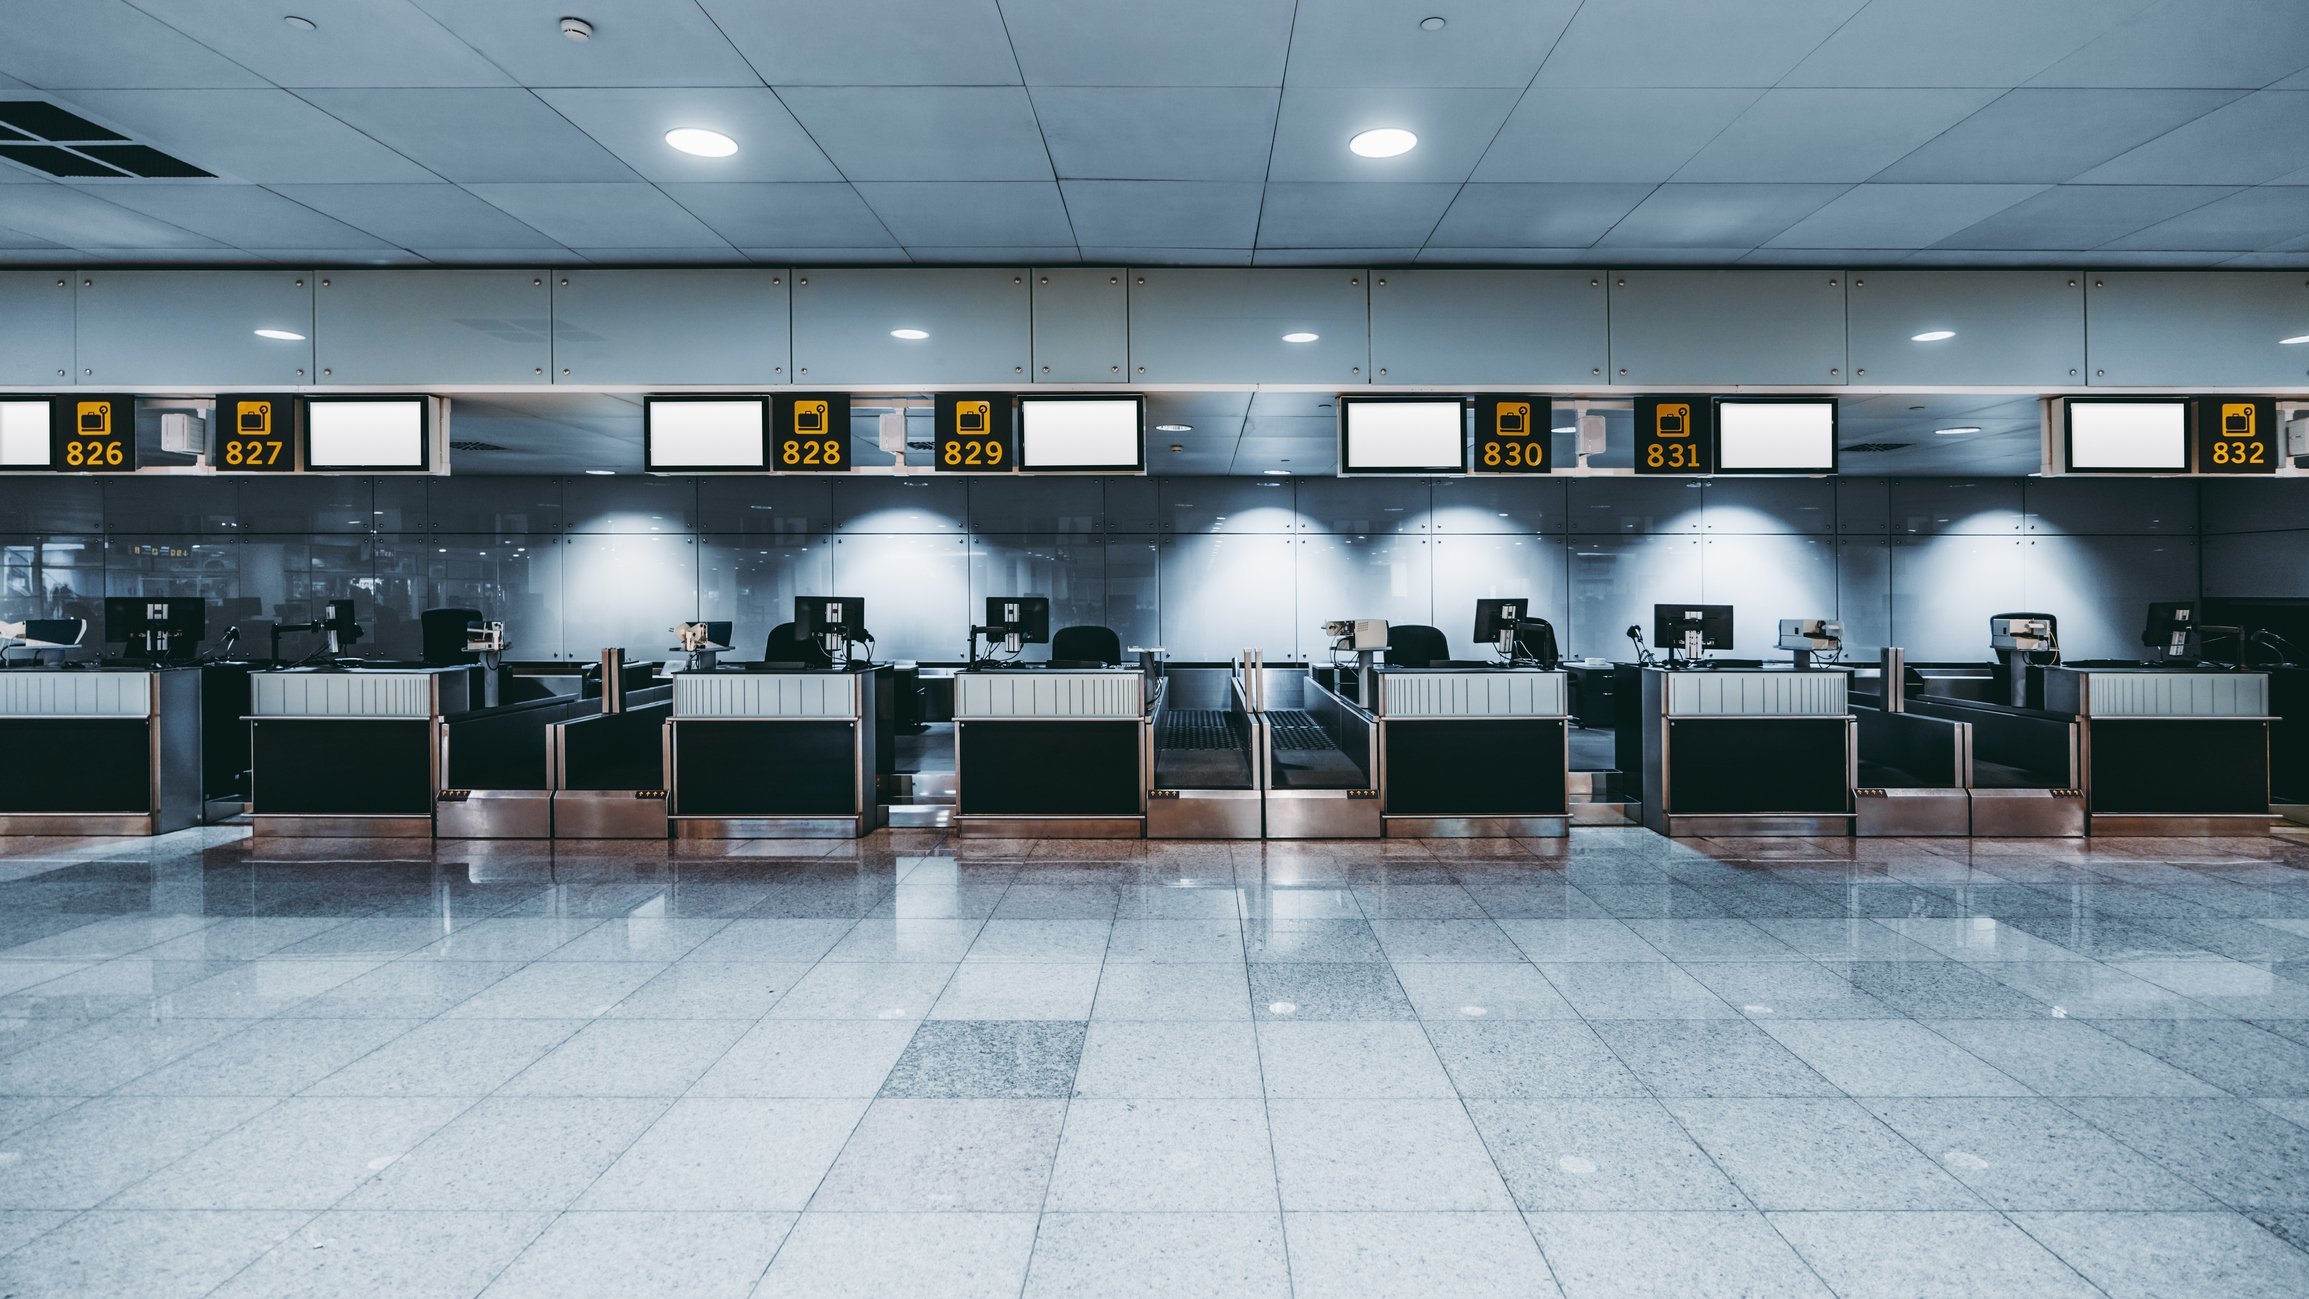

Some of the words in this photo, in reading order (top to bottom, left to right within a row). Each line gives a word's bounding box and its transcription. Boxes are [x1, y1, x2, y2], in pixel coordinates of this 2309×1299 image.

[66, 440, 124, 466] 826
[225, 440, 283, 465] 827
[782, 440, 841, 465] 828
[944, 440, 1003, 466] 829
[1483, 441, 1543, 467] 830
[1647, 443, 1701, 468] 831
[2212, 441, 2266, 465] 832
